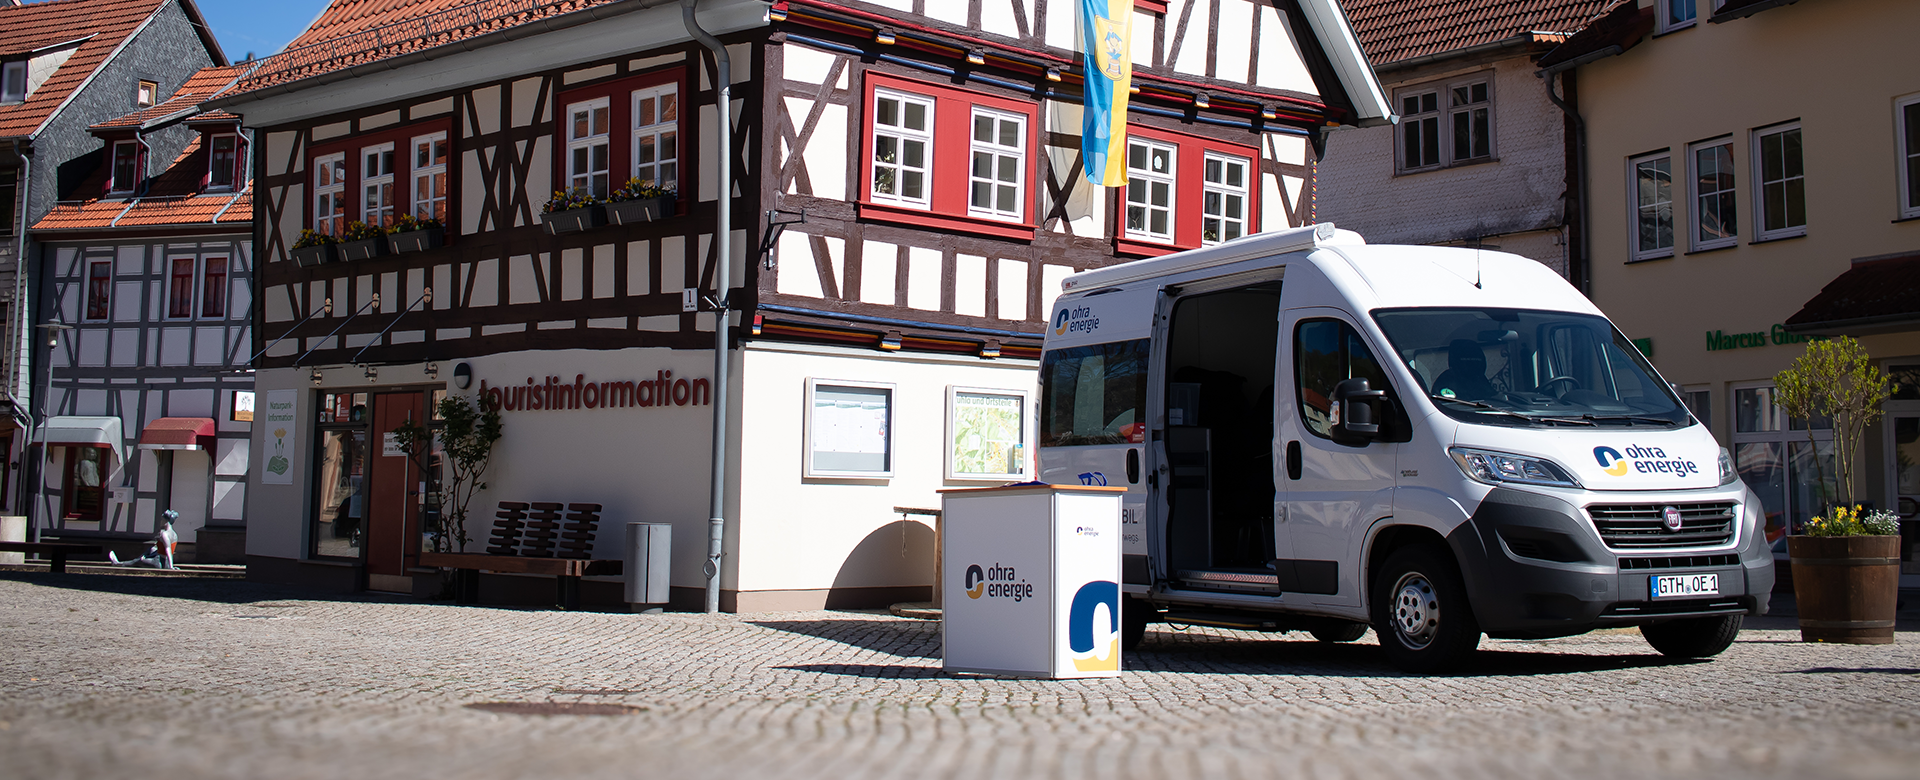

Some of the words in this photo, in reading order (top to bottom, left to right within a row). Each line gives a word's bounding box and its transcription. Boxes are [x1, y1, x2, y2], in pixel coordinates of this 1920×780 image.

[1071, 304, 1090, 320] ohra
[1069, 314, 1100, 334] energie
[1705, 329, 1766, 351] Marcus
[478, 369, 711, 413] touristinformation
[269, 401, 293, 411] Naturpark-
[267, 412, 294, 421] Information
[1625, 443, 1667, 459] ohra
[1634, 456, 1699, 478] energie
[987, 562, 1016, 581] ohra
[987, 578, 1033, 603] energie
[1659, 577, 1684, 594] GTH
